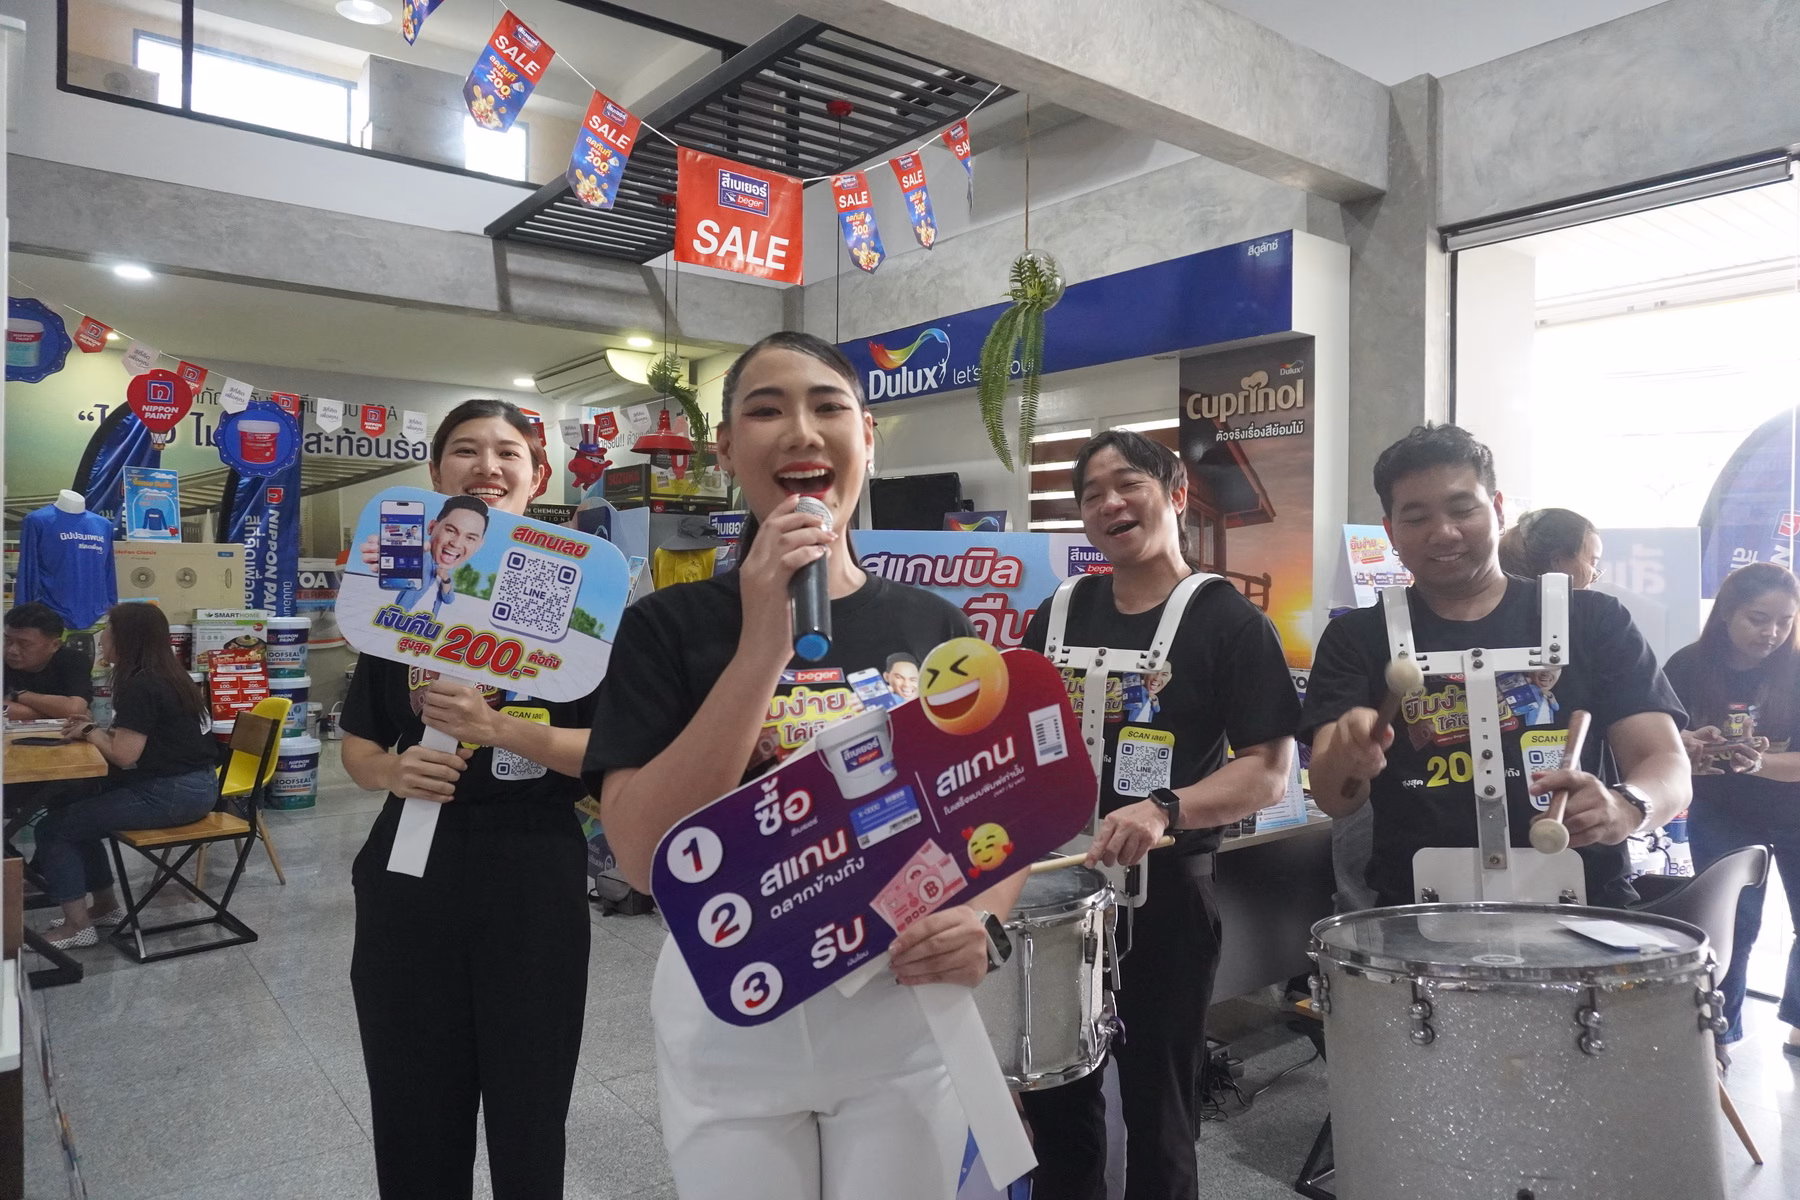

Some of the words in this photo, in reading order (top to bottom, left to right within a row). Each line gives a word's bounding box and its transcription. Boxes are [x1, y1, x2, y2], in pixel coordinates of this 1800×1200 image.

[495, 35, 540, 76] SALE
[589, 115, 631, 150] SALE
[721, 172, 768, 198] สีเบเยอร์
[901, 169, 924, 189] SALE
[737, 194, 764, 208] beger
[838, 191, 869, 209] SALE
[692, 219, 790, 271] SALE
[1247, 238, 1280, 257] สีดูลักซ์
[868, 365, 939, 401] Dulux
[1279, 367, 1301, 376] Dulux
[141, 405, 179, 413] NIPPON
[1215, 420, 1304, 442] ตัวจริงเรื่องสีย้อมไม้
[265, 509, 280, 579] NIPPON
[512, 526, 588, 558] สแกนเลย
[297, 572, 329, 589] OA
[860, 550, 1019, 584] สแกนบิล
[263, 581, 277, 617] PAIN
[522, 587, 547, 601] LINE
[375, 606, 442, 640] เงินคืน
[398, 637, 431, 657] สูงสุด
[436, 627, 537, 678] 200.-
[527, 650, 561, 670] ต่อถัง
[797, 670, 839, 681] beger
[507, 710, 532, 719] SCAN
[765, 691, 846, 721] มง่าย
[1127, 731, 1151, 740] SCAN
[1151, 734, 1167, 742] เลย!
[1531, 735, 1558, 743] SCAN
[936, 735, 1015, 798] สแกน
[1135, 766, 1152, 774] LINE
[1426, 751, 1473, 788] 20
[753, 776, 811, 837] ซื้อ
[681, 836, 704, 873] 1
[760, 829, 848, 897] สแกน
[770, 856, 865, 920] ฉลากข้างถัง
[711, 905, 741, 945] 2
[810, 916, 865, 970] รับ
[743, 971, 771, 1009] 3
